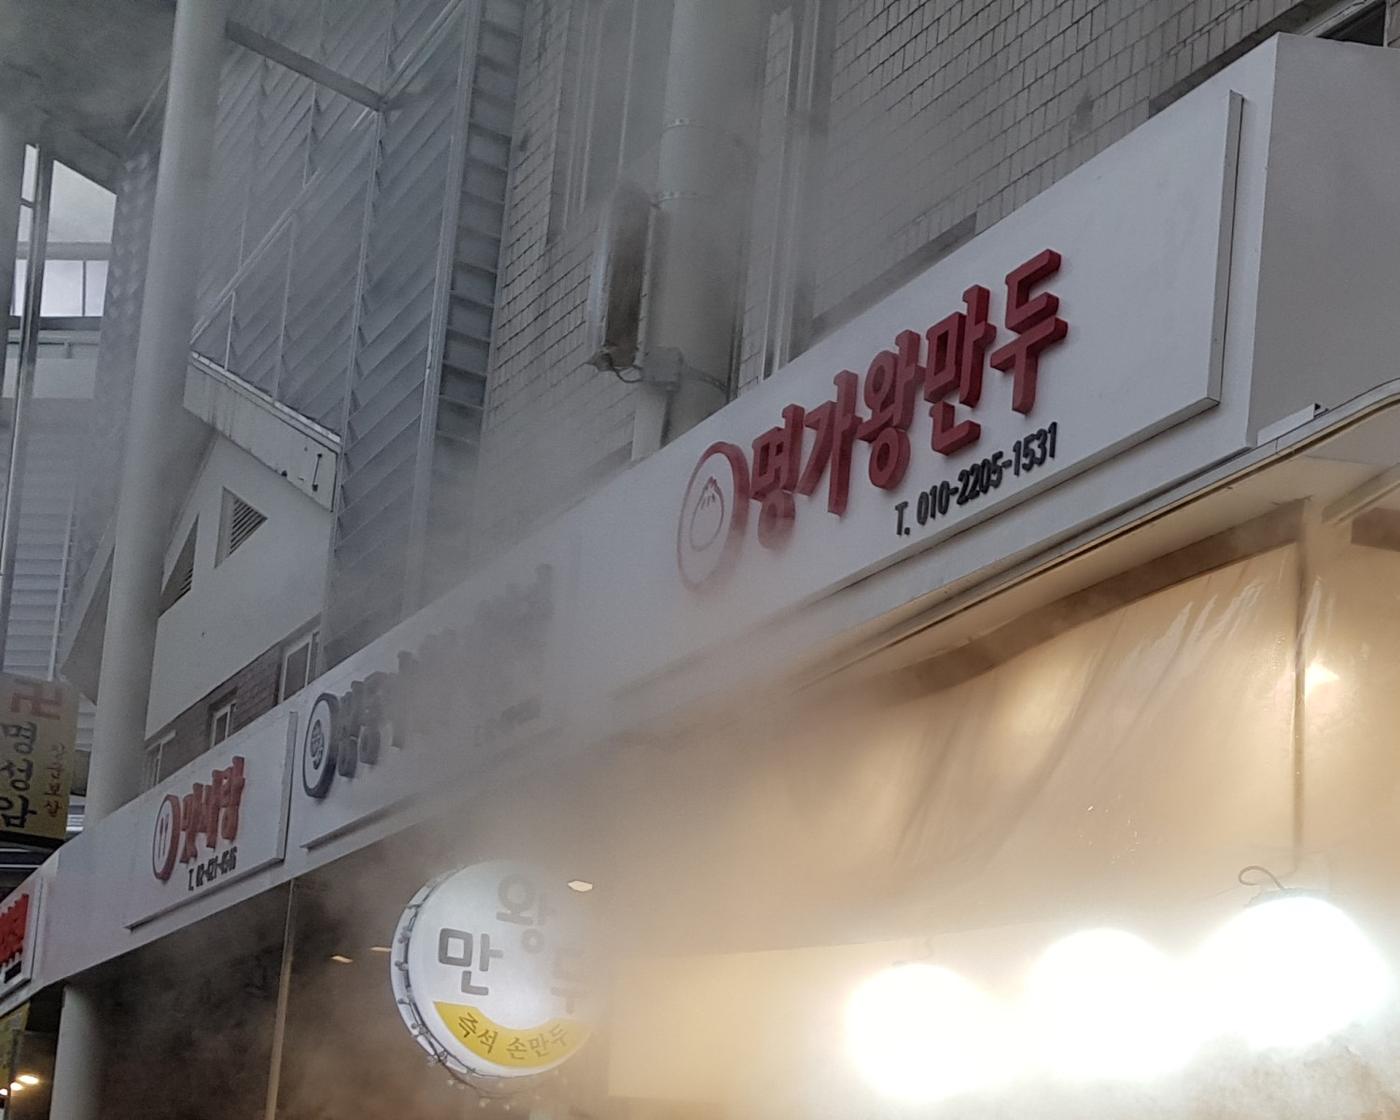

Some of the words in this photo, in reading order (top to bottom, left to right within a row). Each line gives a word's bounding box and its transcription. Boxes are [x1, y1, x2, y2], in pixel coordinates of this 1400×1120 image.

[750, 248, 1069, 552] 명가왕만두
[916, 421, 1058, 527] 010-2205-1531
[458, 1012, 499, 1054] 즉석
[506, 1024, 568, 1060] 손만두
